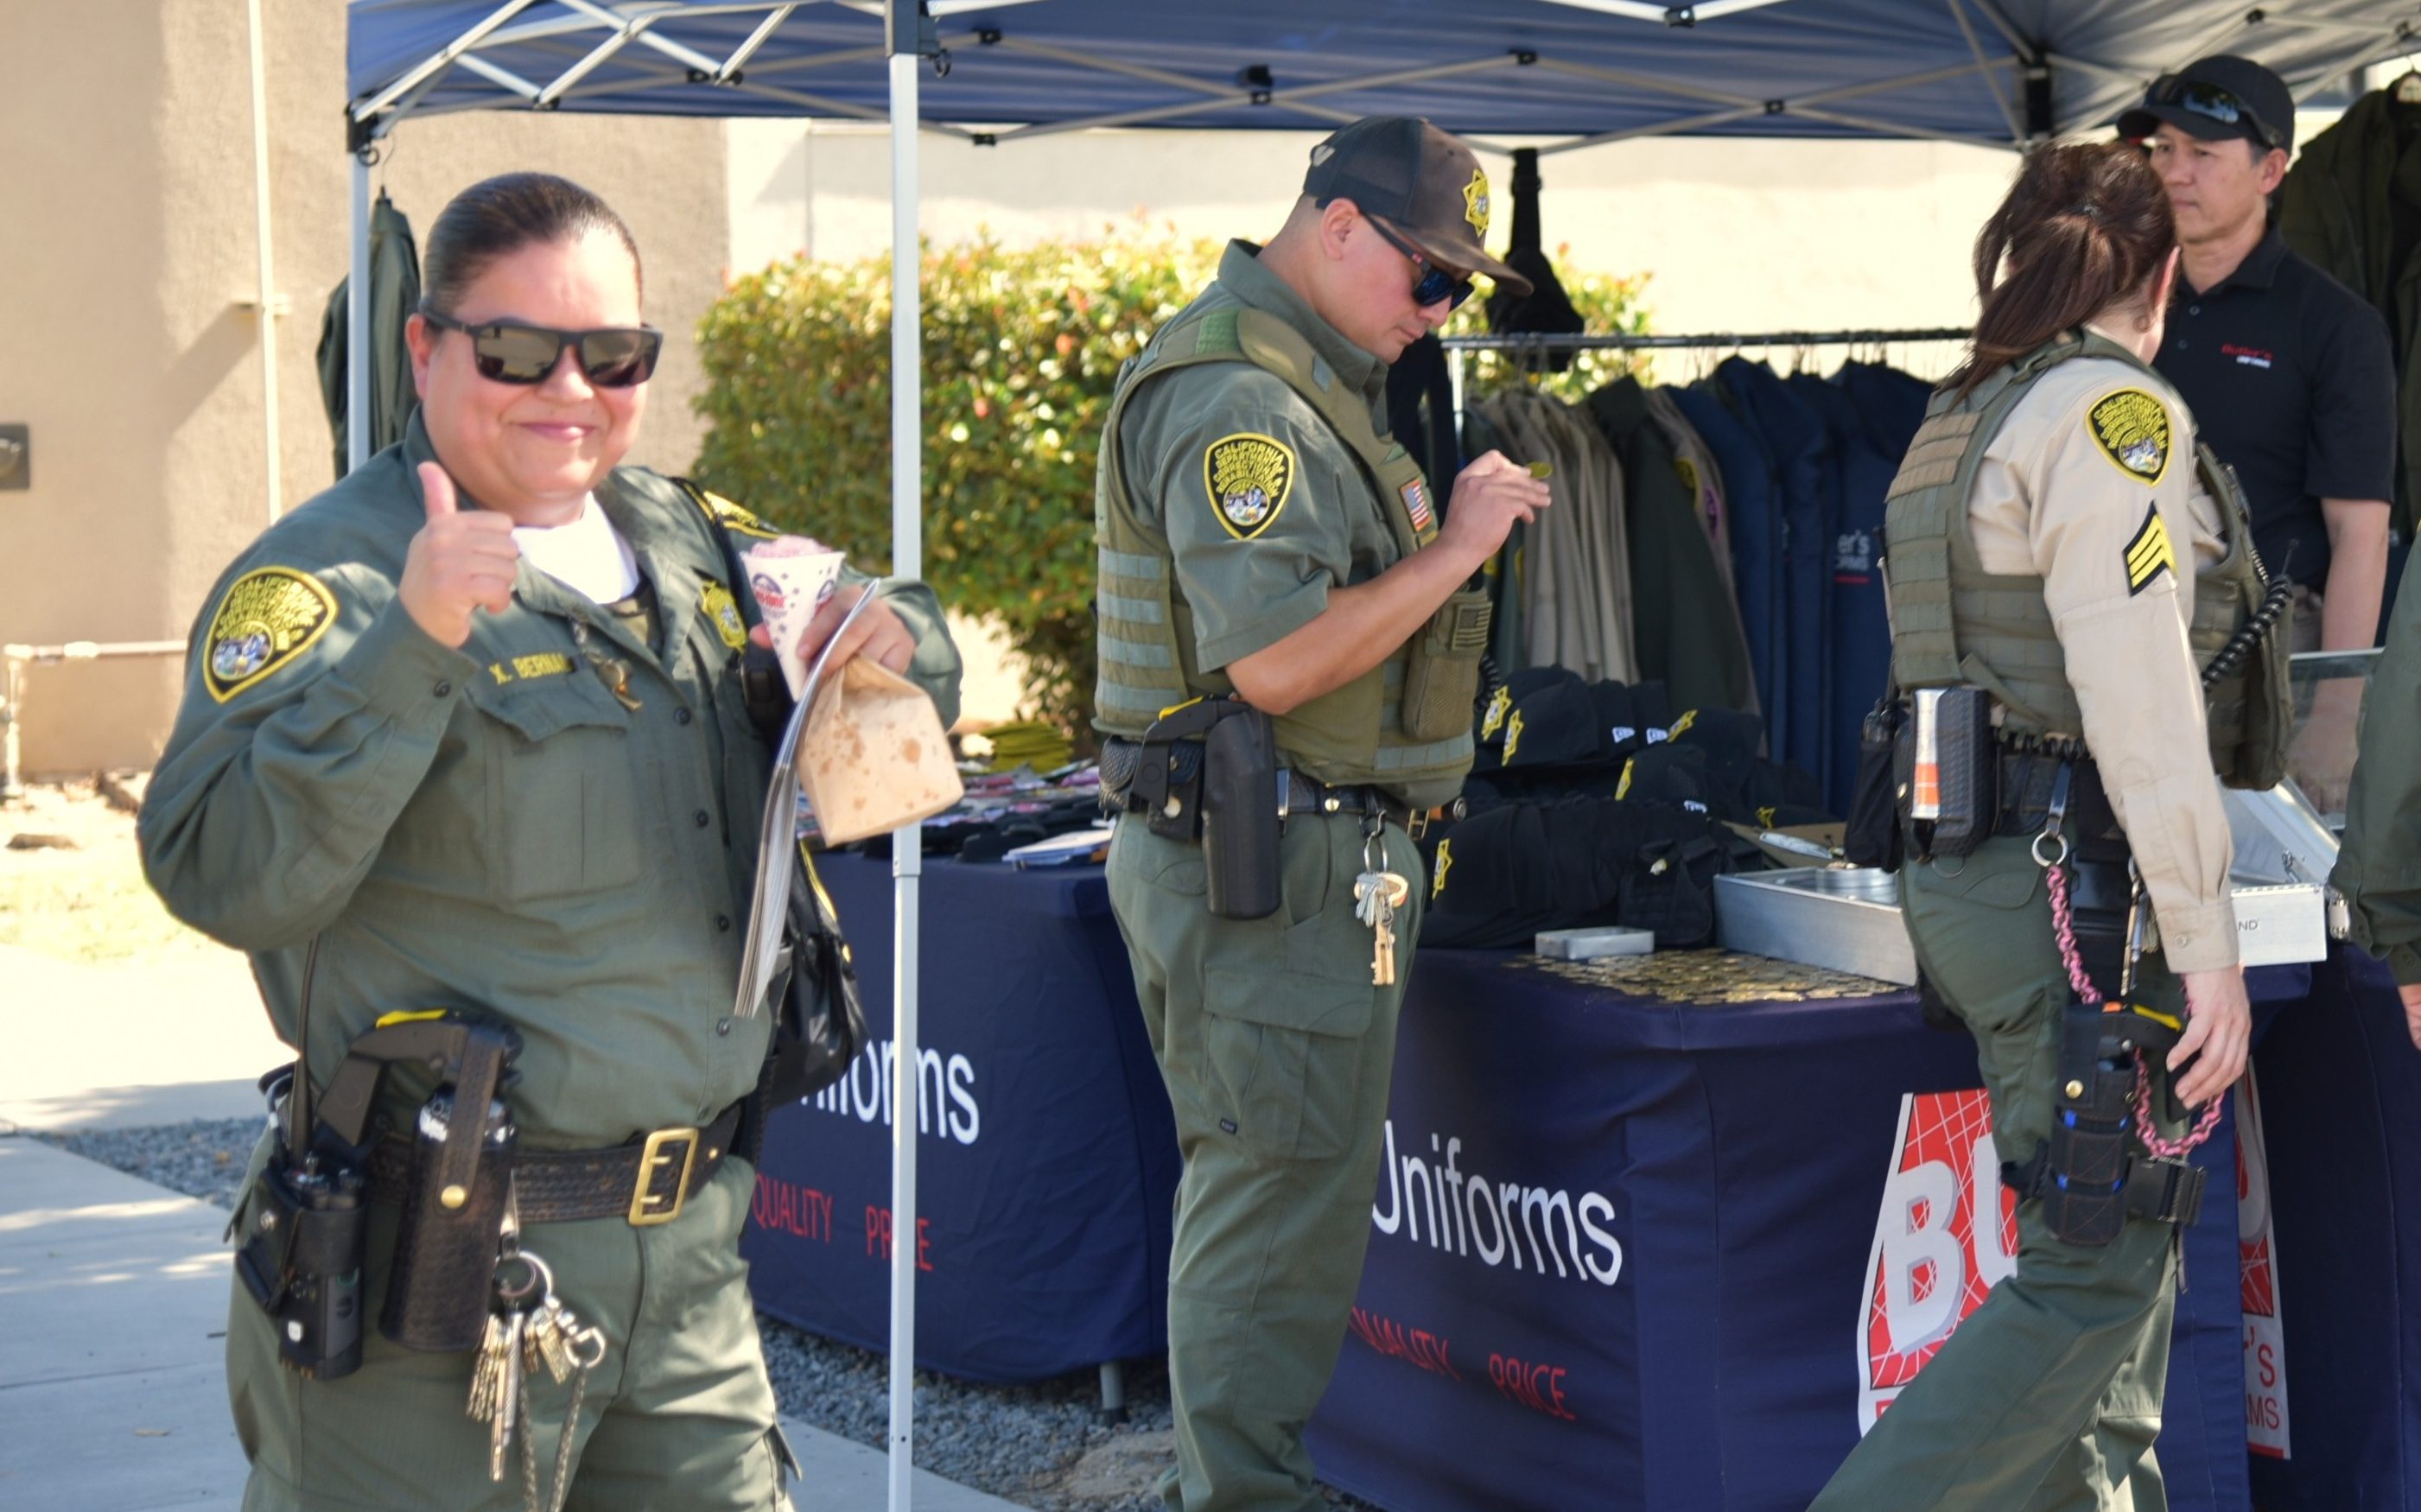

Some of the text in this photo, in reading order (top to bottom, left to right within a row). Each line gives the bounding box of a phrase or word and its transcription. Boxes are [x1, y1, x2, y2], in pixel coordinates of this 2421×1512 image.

[1214, 441, 1285, 466] CALIFORNIA
[752, 1172, 934, 1273] QUALITY PRE
[1372, 1120, 1623, 1286] Uniforms
[1490, 1353, 1576, 1421] PRICE
